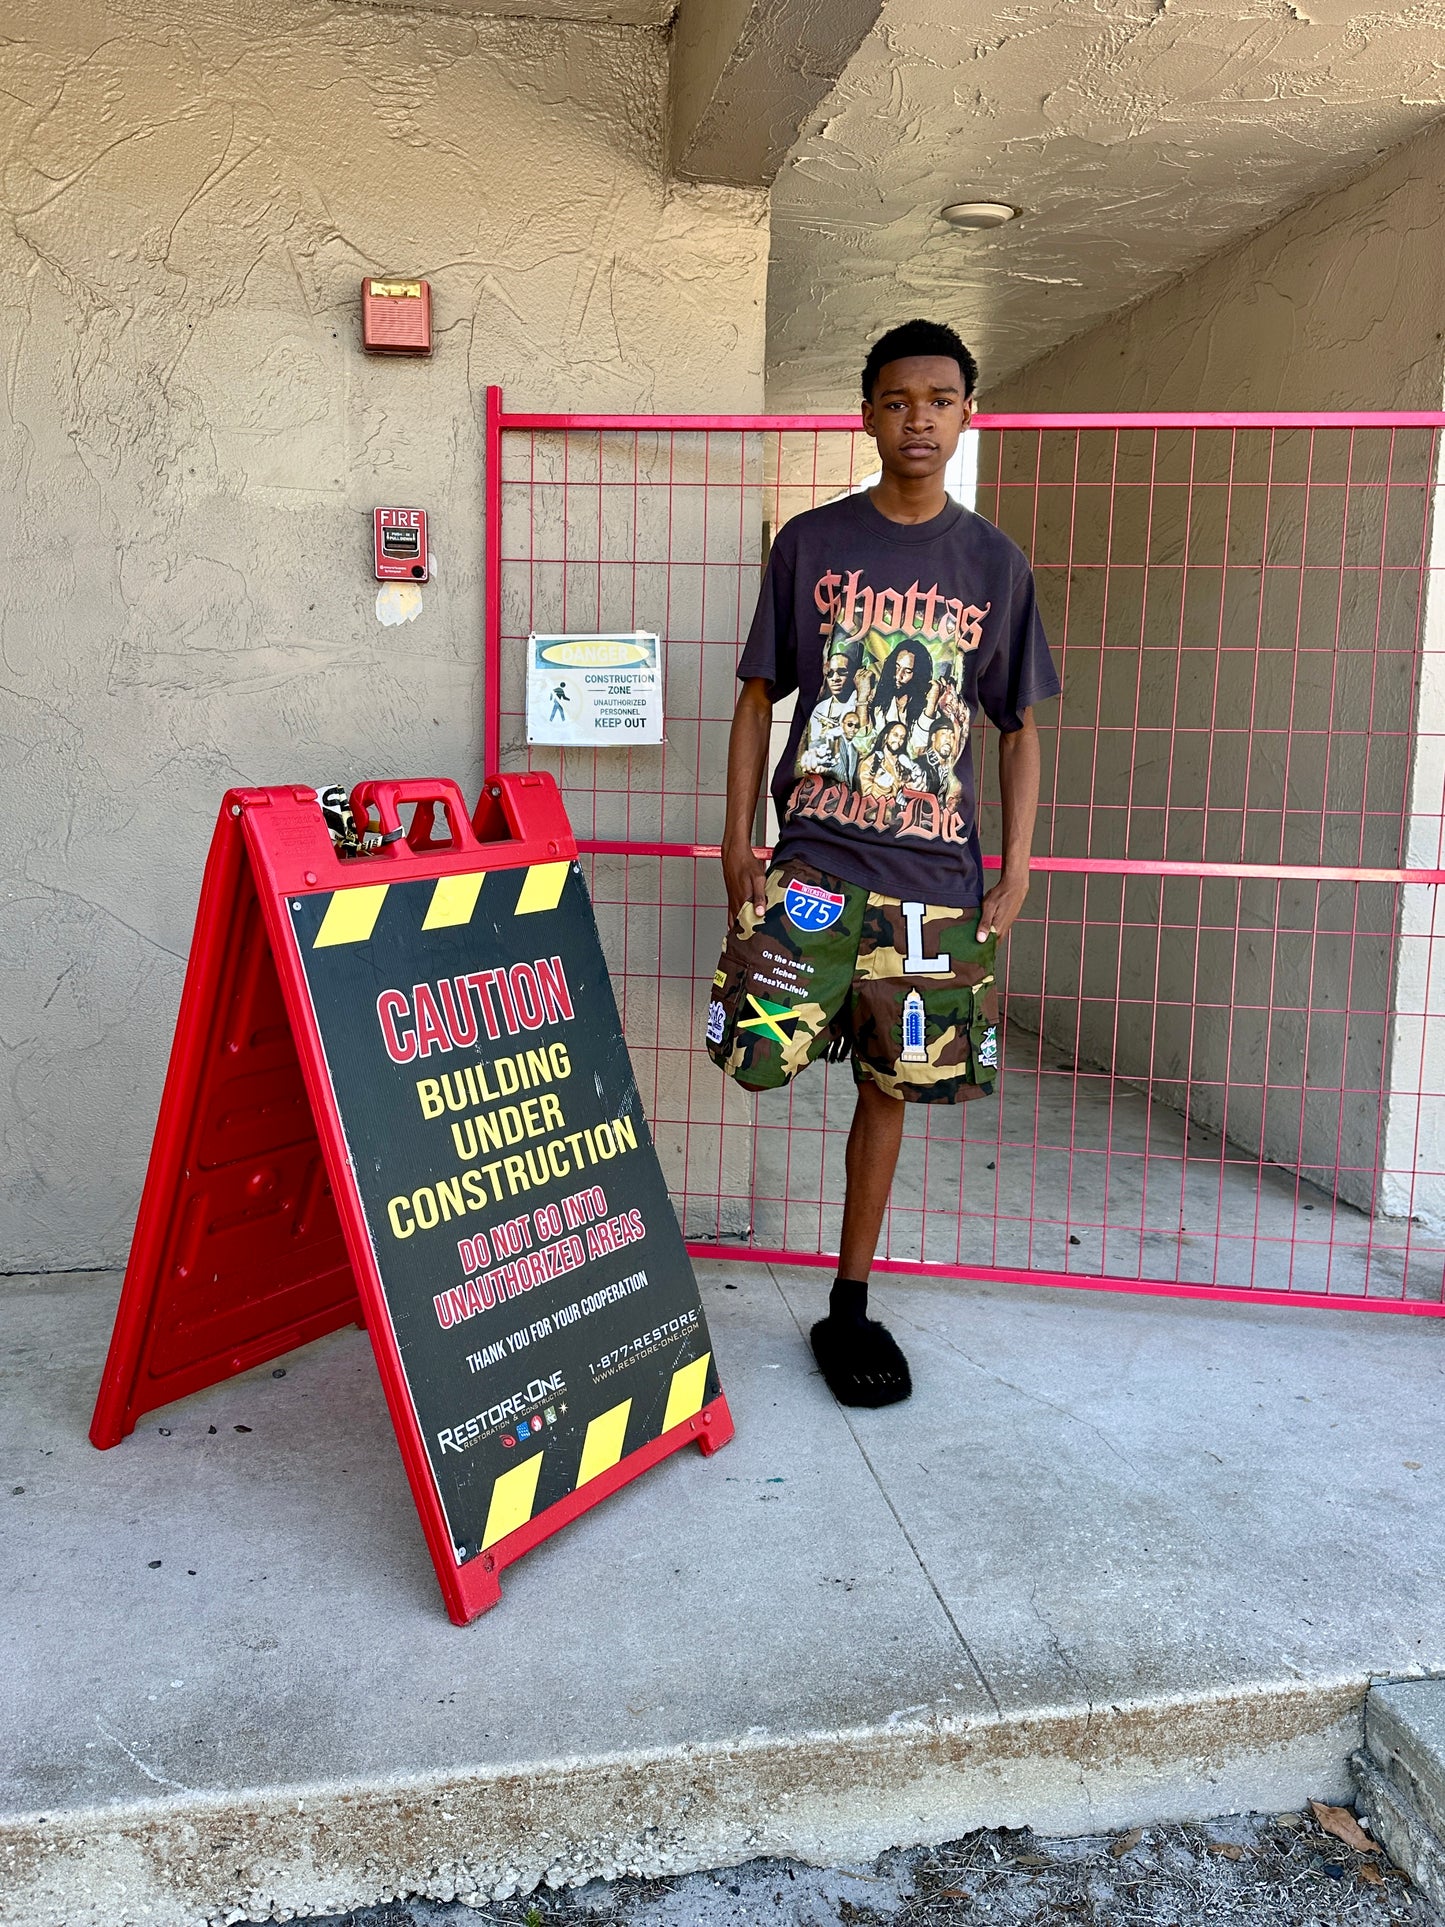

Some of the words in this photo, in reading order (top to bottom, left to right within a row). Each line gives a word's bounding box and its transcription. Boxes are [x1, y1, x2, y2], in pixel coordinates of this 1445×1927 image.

[381, 511, 420, 526] FIRE
[562, 645, 629, 662] DANGER
[585, 674, 655, 683] CONSTRUCTION
[608, 686, 632, 694] ZONE
[594, 718, 622, 728] KEEP
[624, 718, 647, 728] OUT
[784, 773, 896, 833] Never
[894, 787, 968, 845] Die
[790, 896, 832, 924] 275
[801, 886, 832, 900] INTERSTATE
[762, 950, 773, 960] On
[774, 955, 787, 964] the
[788, 961, 806, 971] road
[807, 965, 815, 973] to
[902, 902, 951, 974] L
[772, 967, 797, 980] riches
[376, 955, 575, 1065] CAUTION
[416, 1042, 572, 1121] BUILDING
[451, 1093, 566, 1161] UNDER
[387, 1115, 638, 1239] CONSTRUCTION
[457, 1232, 491, 1275] DO
[490, 1213, 533, 1261] NOT
[533, 1203, 564, 1242] GO
[561, 1185, 608, 1231] INTO
[433, 1234, 586, 1330] UNAUTHORIZED
[585, 1208, 646, 1261] AREAS
[465, 1340, 507, 1374] THANK
[506, 1328, 530, 1354] YOU
[530, 1317, 553, 1341] FOR
[551, 1303, 582, 1330] YOUR
[581, 1270, 649, 1316] COOPERATION
[588, 1309, 698, 1375] 1-877-RESTORE
[592, 1322, 699, 1384] WWW.RESTORE-ONE.COM
[463, 1420, 510, 1449] RESTORATION
[521, 1387, 568, 1416] CONSTRUCTION
